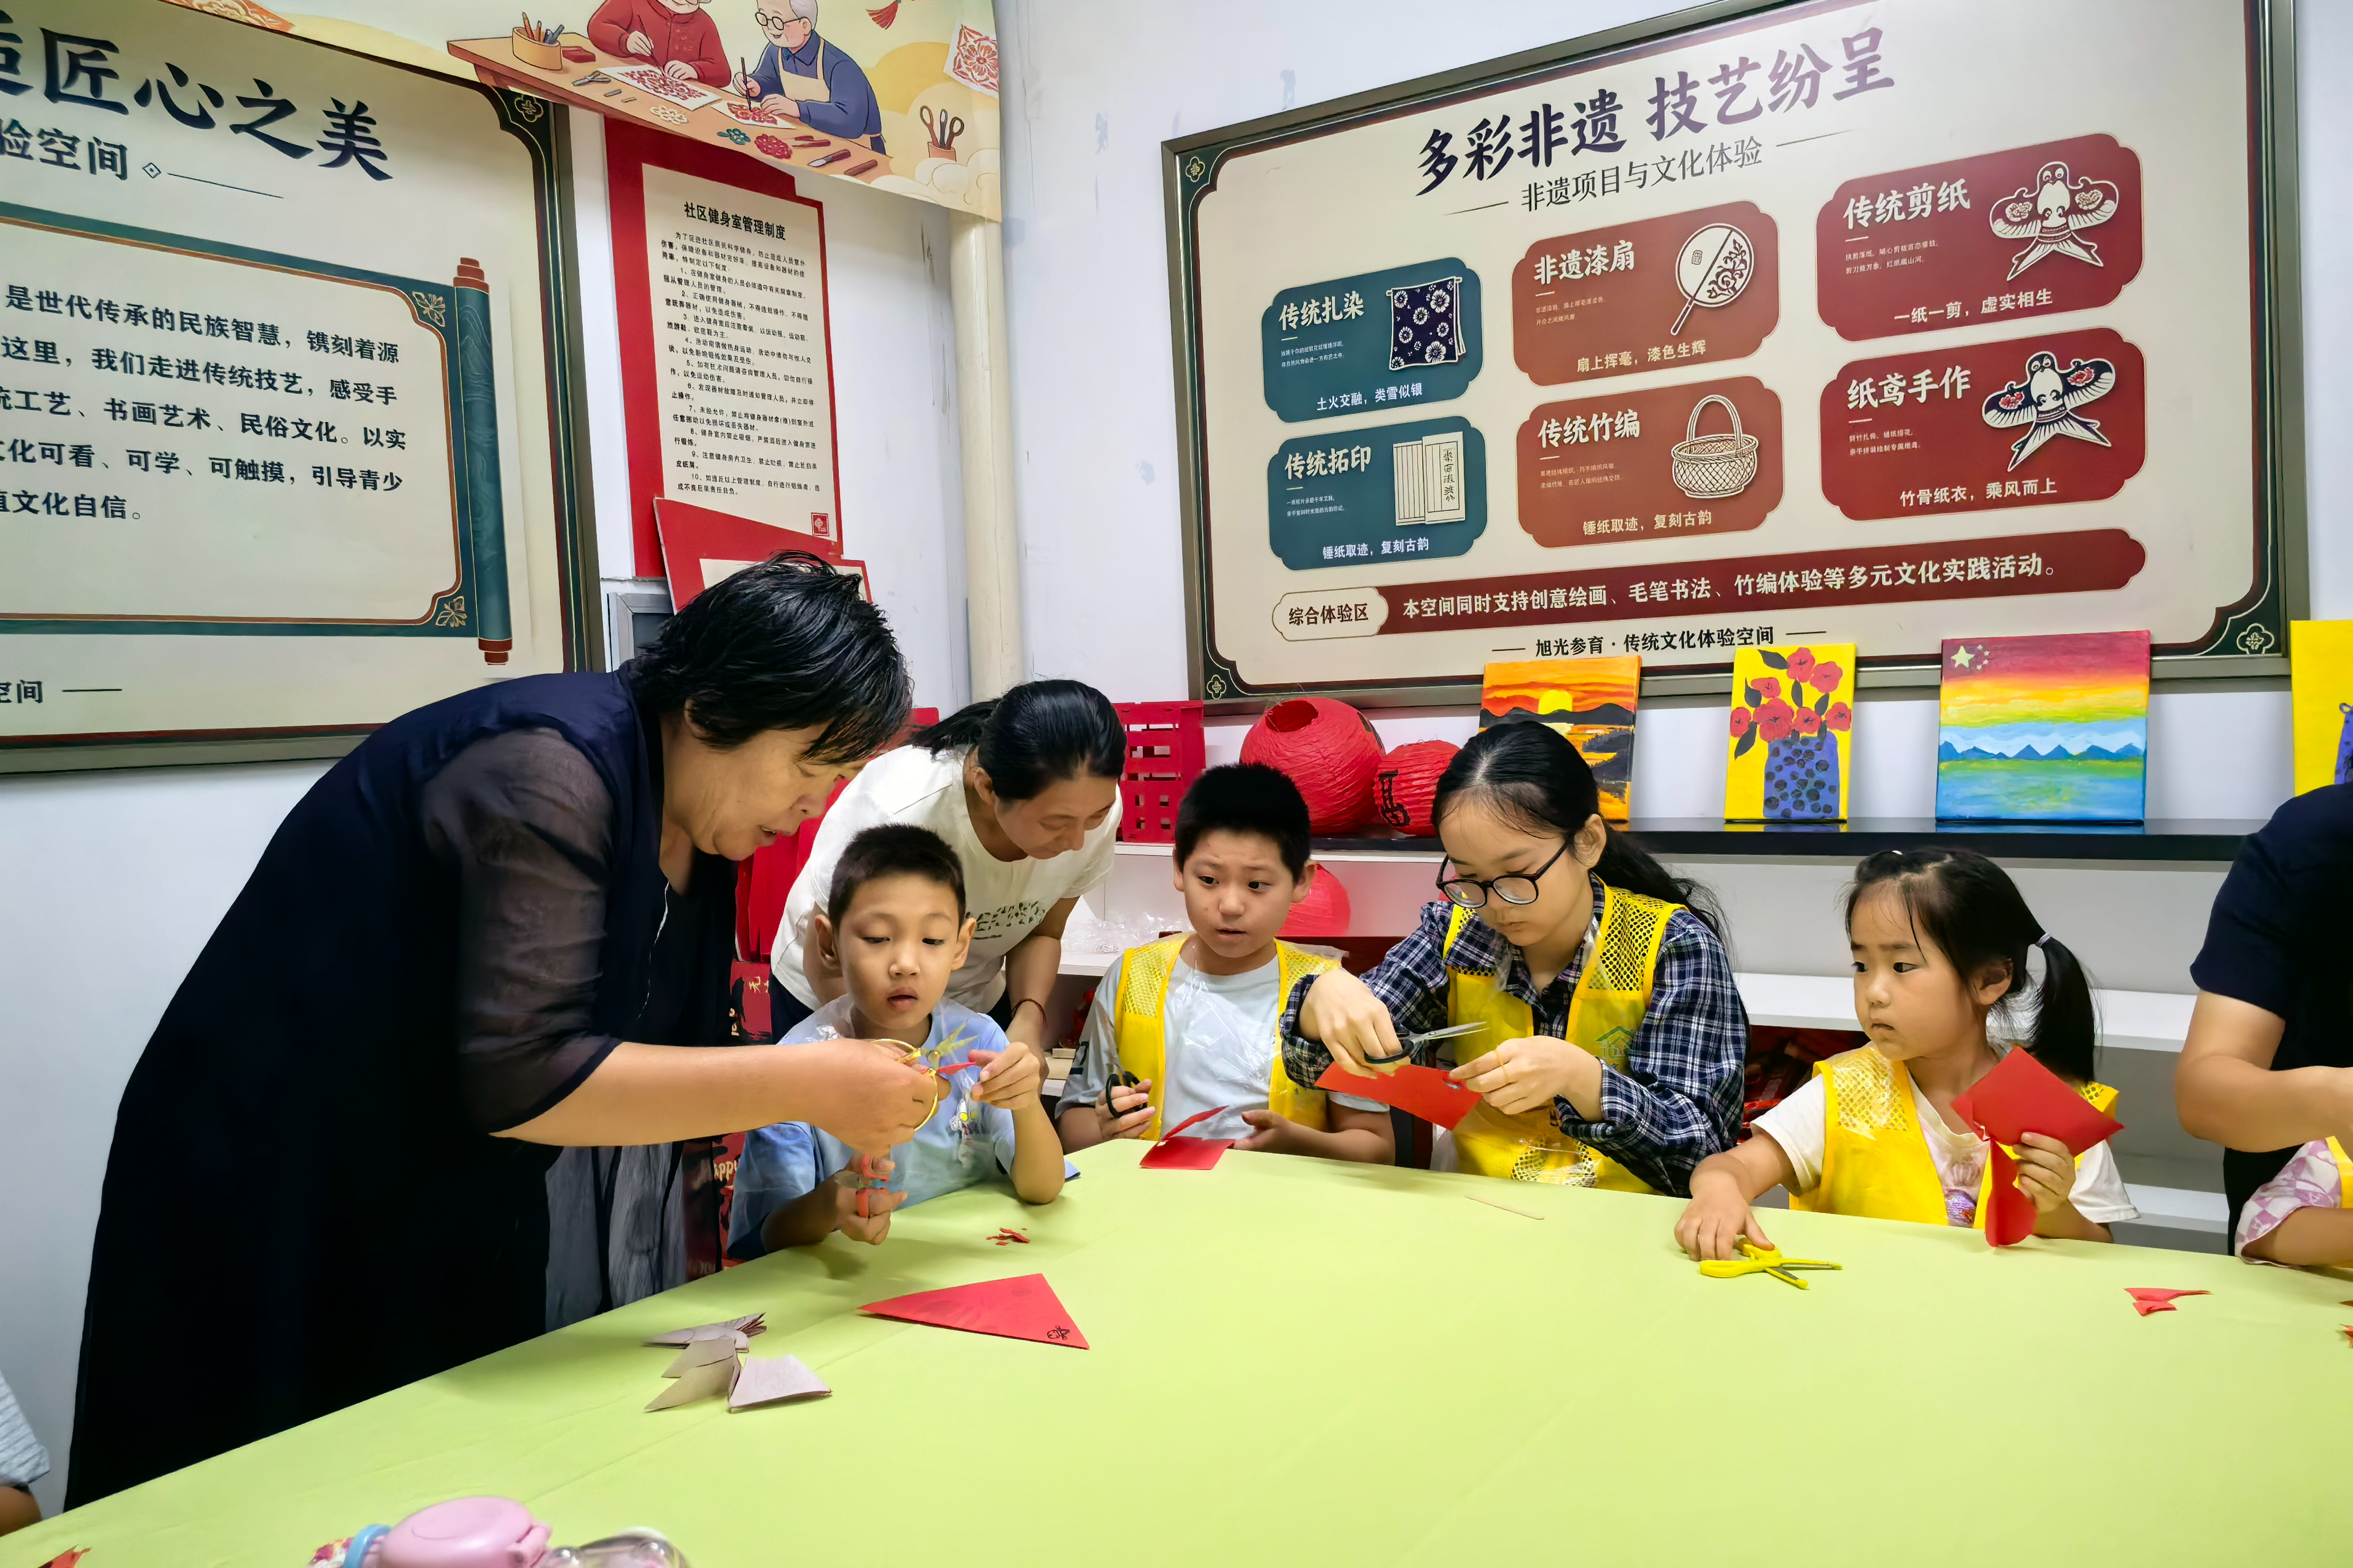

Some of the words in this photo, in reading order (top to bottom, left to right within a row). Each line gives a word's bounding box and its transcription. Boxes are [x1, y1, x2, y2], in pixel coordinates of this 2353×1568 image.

[1415, 88, 1627, 196] 多彩非遗
[1646, 27, 1895, 141] 技艺纷呈
[1521, 137, 1762, 212] 非遗项目与文化体验
[684, 202, 786, 241] 社区健身室管理制度
[1843, 178, 1970, 230] 传统剪纸
[1534, 240, 1635, 285] 非遗漆扇
[6, 284, 399, 364] 是世代传承的民族智慧，镌刻着源
[1278, 291, 1365, 331] 传统扎染
[1894, 288, 2053, 322] 一纸一剪，虚实相生
[1, 336, 398, 407] 这里，我们走进传统技艺，感受手
[1577, 339, 1706, 373] 扇上挥毫，漆色生辉
[1847, 366, 1970, 409] 纸鸢手作
[1538, 409, 1640, 448] 传统竹编
[0, 439, 402, 493] 化可看、可学、可触摸，引导青少
[1284, 445, 1371, 480] 传统拓印
[1900, 478, 2057, 507] 竹骨纸衣，乘风而上
[1583, 509, 1711, 535] 锤纸取迹，复刻古韵
[1322, 537, 1429, 559] 锤纸取迹，复刻古韵
[1403, 553, 2054, 619] 本空间同时支持创意绘画、毛笔书法、竹编体验等多元文化实践活动。
[1289, 603, 1369, 626] 综合体验区
